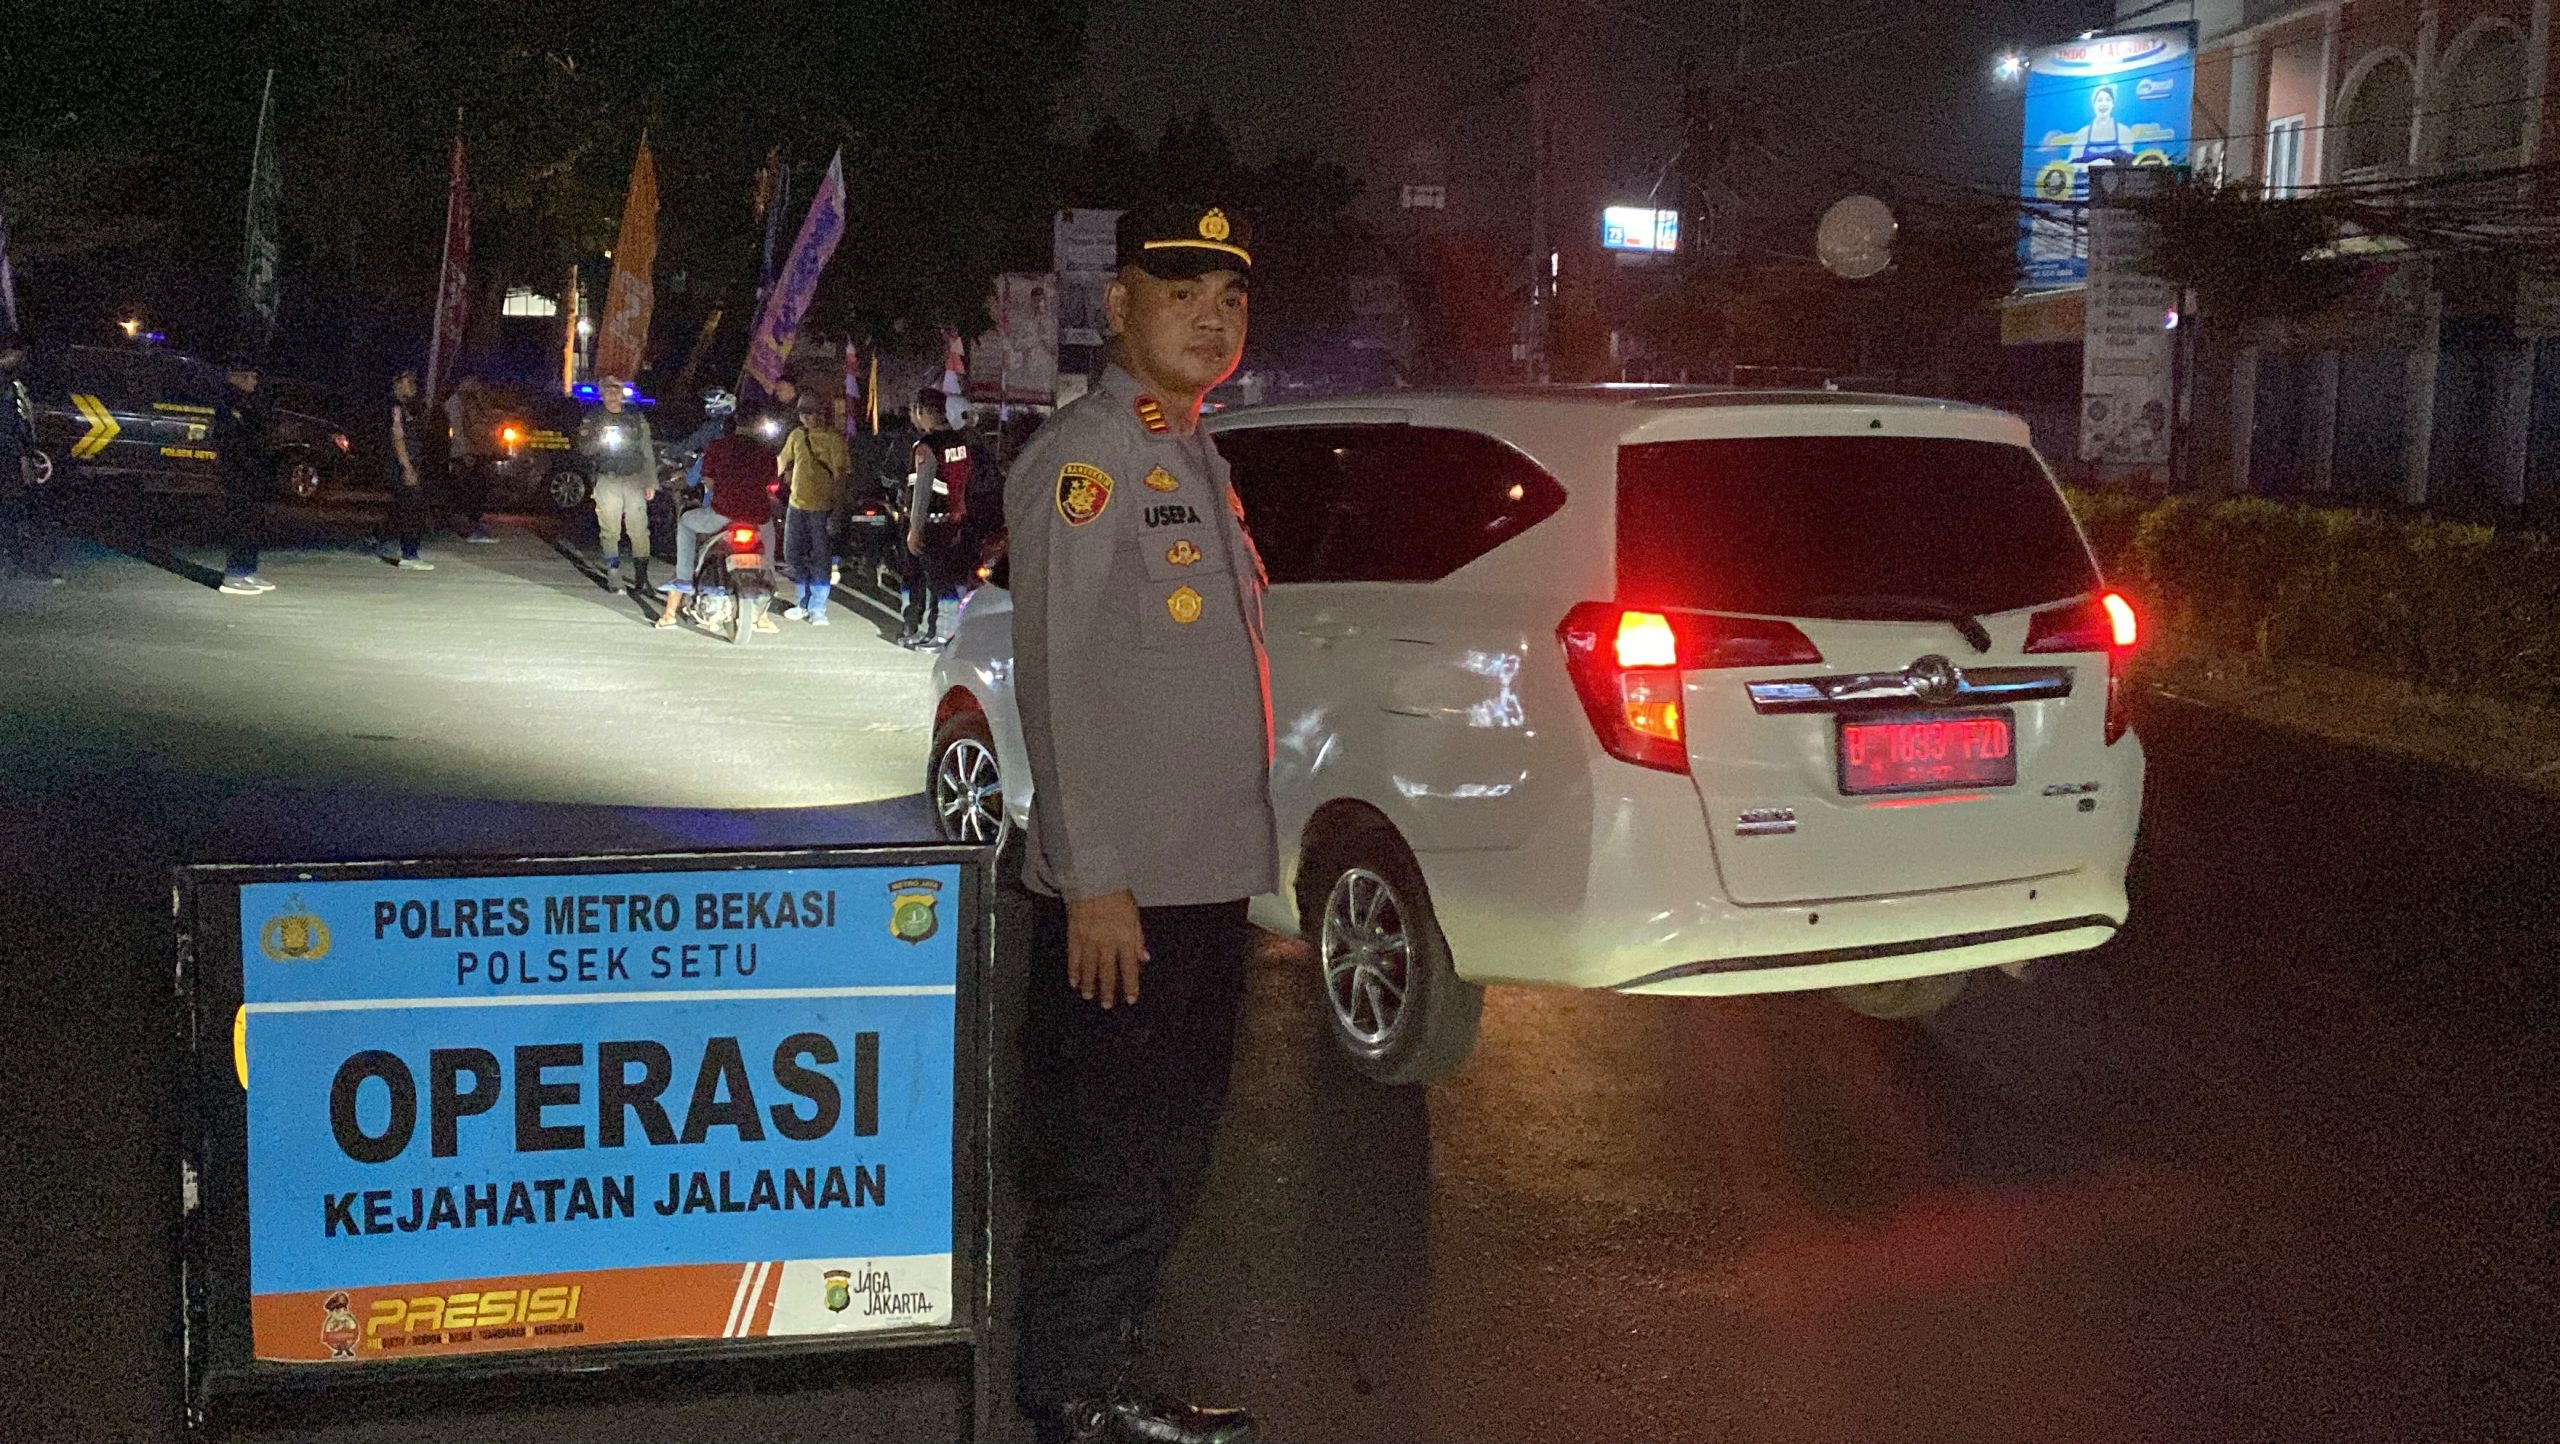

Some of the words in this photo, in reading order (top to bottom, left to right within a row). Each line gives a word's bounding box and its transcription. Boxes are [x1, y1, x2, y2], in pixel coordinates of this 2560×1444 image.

[1847, 726, 1864, 765] B
[375, 898, 529, 938] POLRES
[545, 894, 679, 934] METRO
[696, 892, 834, 929] BEKASI
[458, 948, 627, 984] POLSEK
[652, 944, 755, 978] SETU
[330, 1032, 879, 1163] OPERASI
[325, 1176, 634, 1236] KEJAHATAN
[655, 1165, 885, 1215] JALANAN
[854, 1270, 891, 1293] JAGA
[367, 1285, 581, 1336] PRESISI
